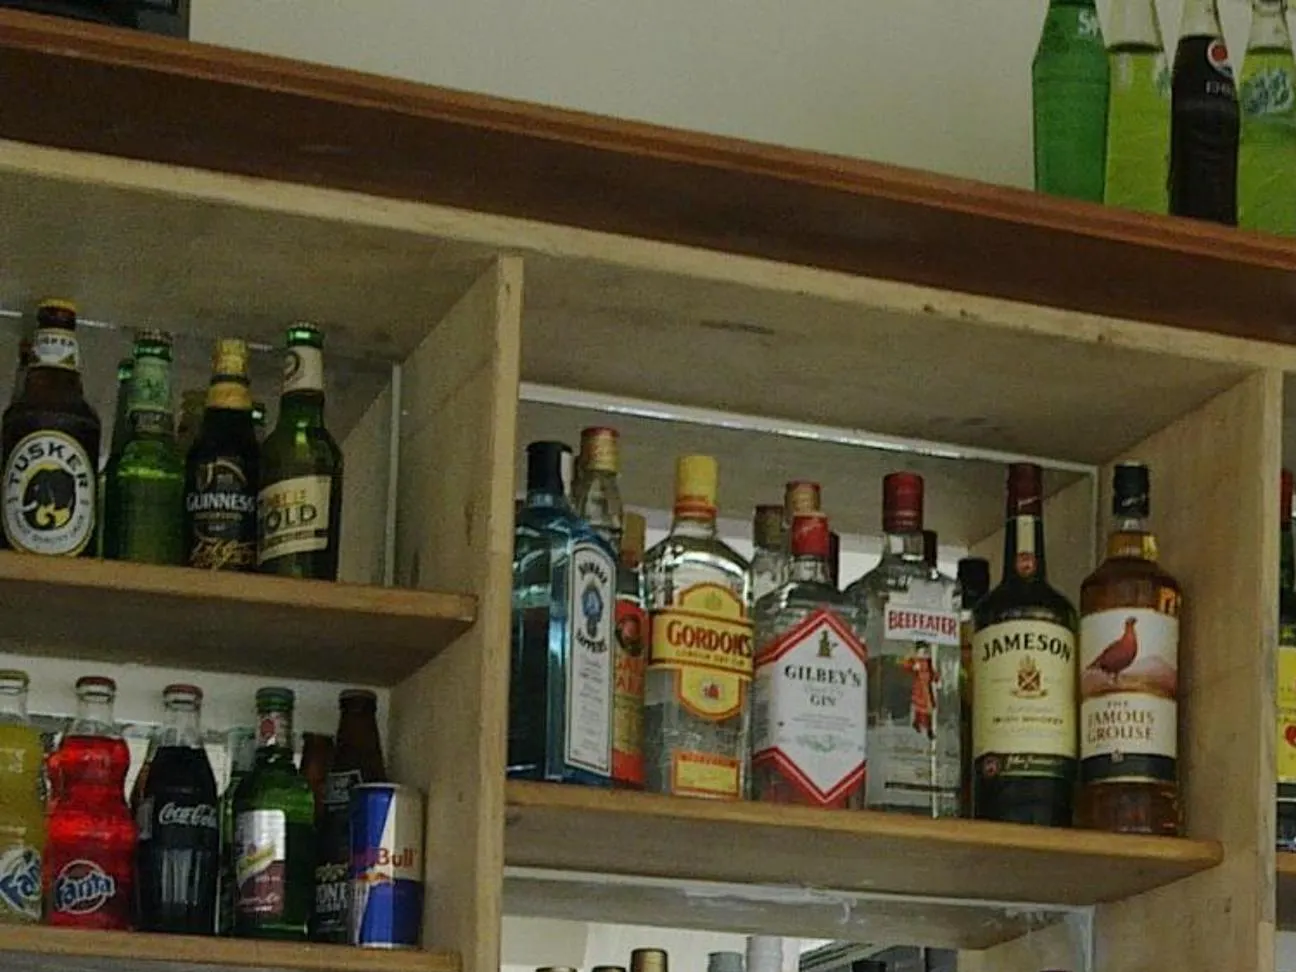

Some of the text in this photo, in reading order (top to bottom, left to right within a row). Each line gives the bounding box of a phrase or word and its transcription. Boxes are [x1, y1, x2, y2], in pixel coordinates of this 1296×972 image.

[8, 442, 89, 489] TUSKER
[186, 491, 255, 512] GUINNESS
[264, 503, 318, 534] OLD
[888, 609, 958, 639] BEEFEATER
[981, 632, 1072, 664] JAMESON
[784, 663, 862, 687] GILBEY'S
[1087, 708, 1155, 728] FAMOUS
[376, 847, 416, 868] Bull
